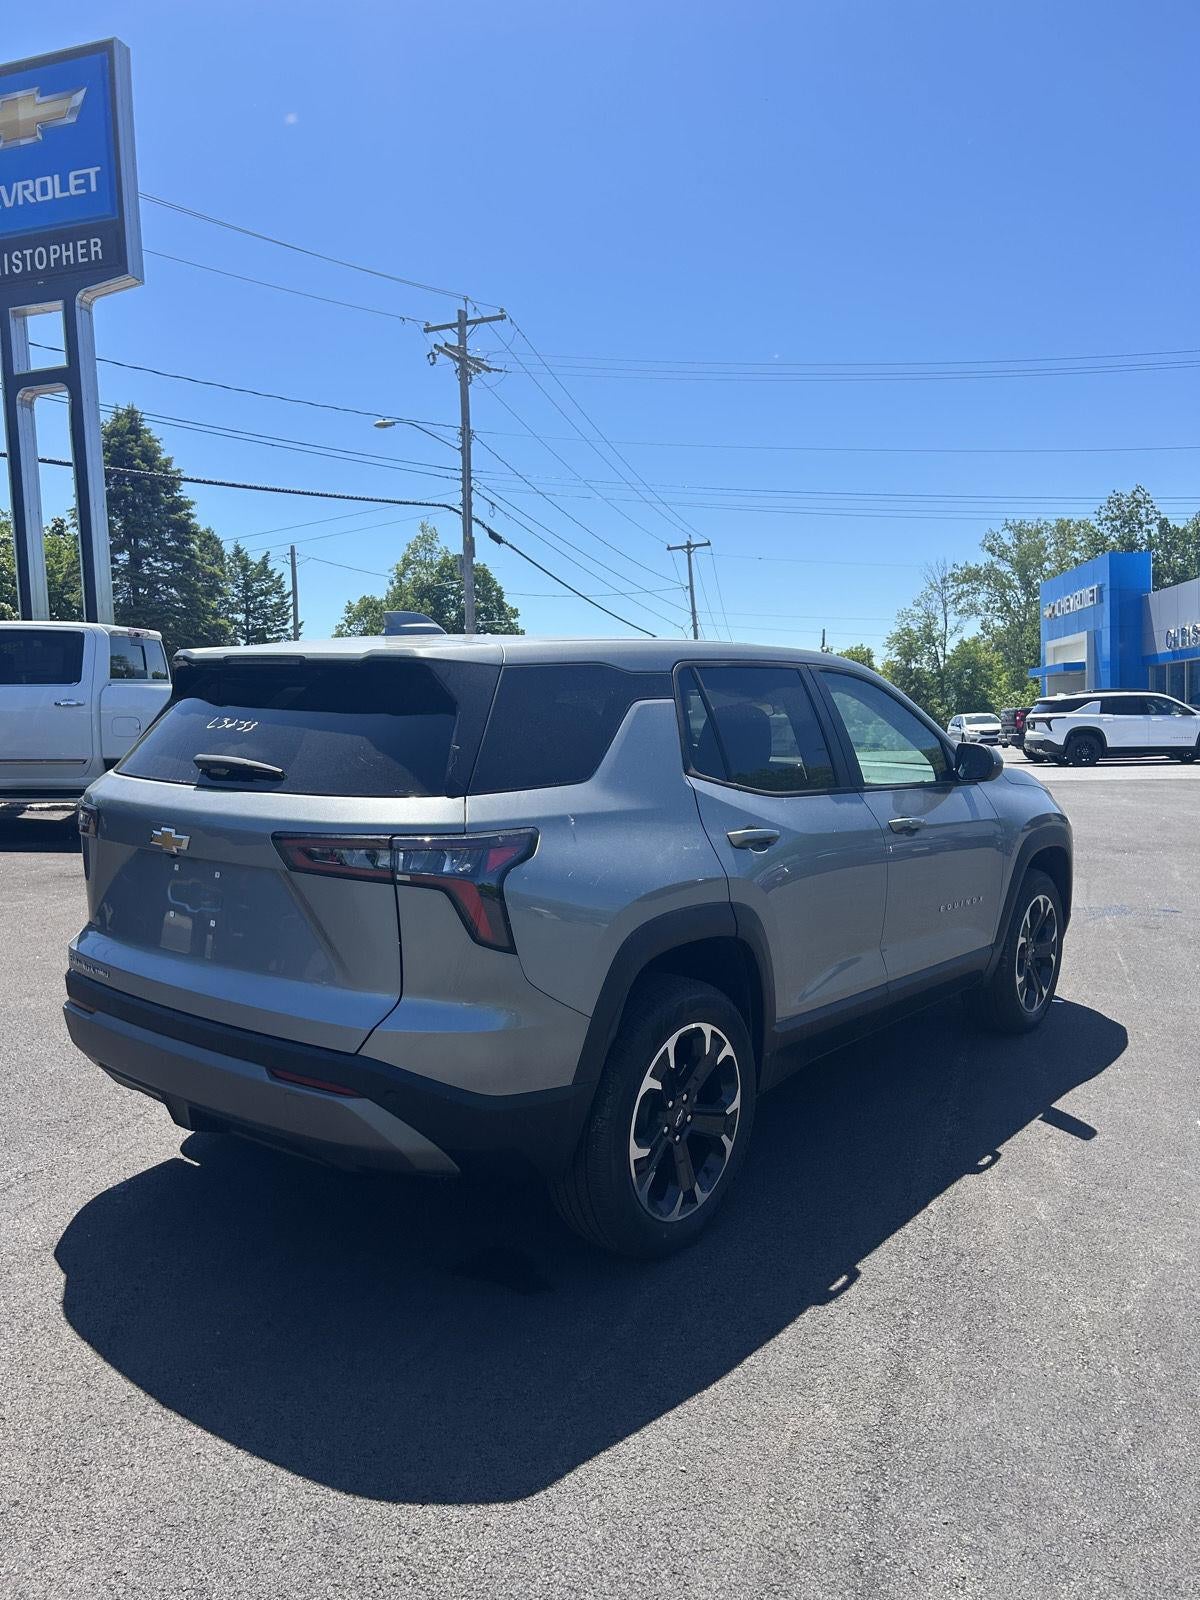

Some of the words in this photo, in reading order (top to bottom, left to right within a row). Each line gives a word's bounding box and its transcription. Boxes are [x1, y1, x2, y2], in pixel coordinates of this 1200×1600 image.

[0, 166, 101, 208] VROLET
[0, 237, 103, 275] ISTOPHER
[1055, 584, 1098, 617] CHEVROLET
